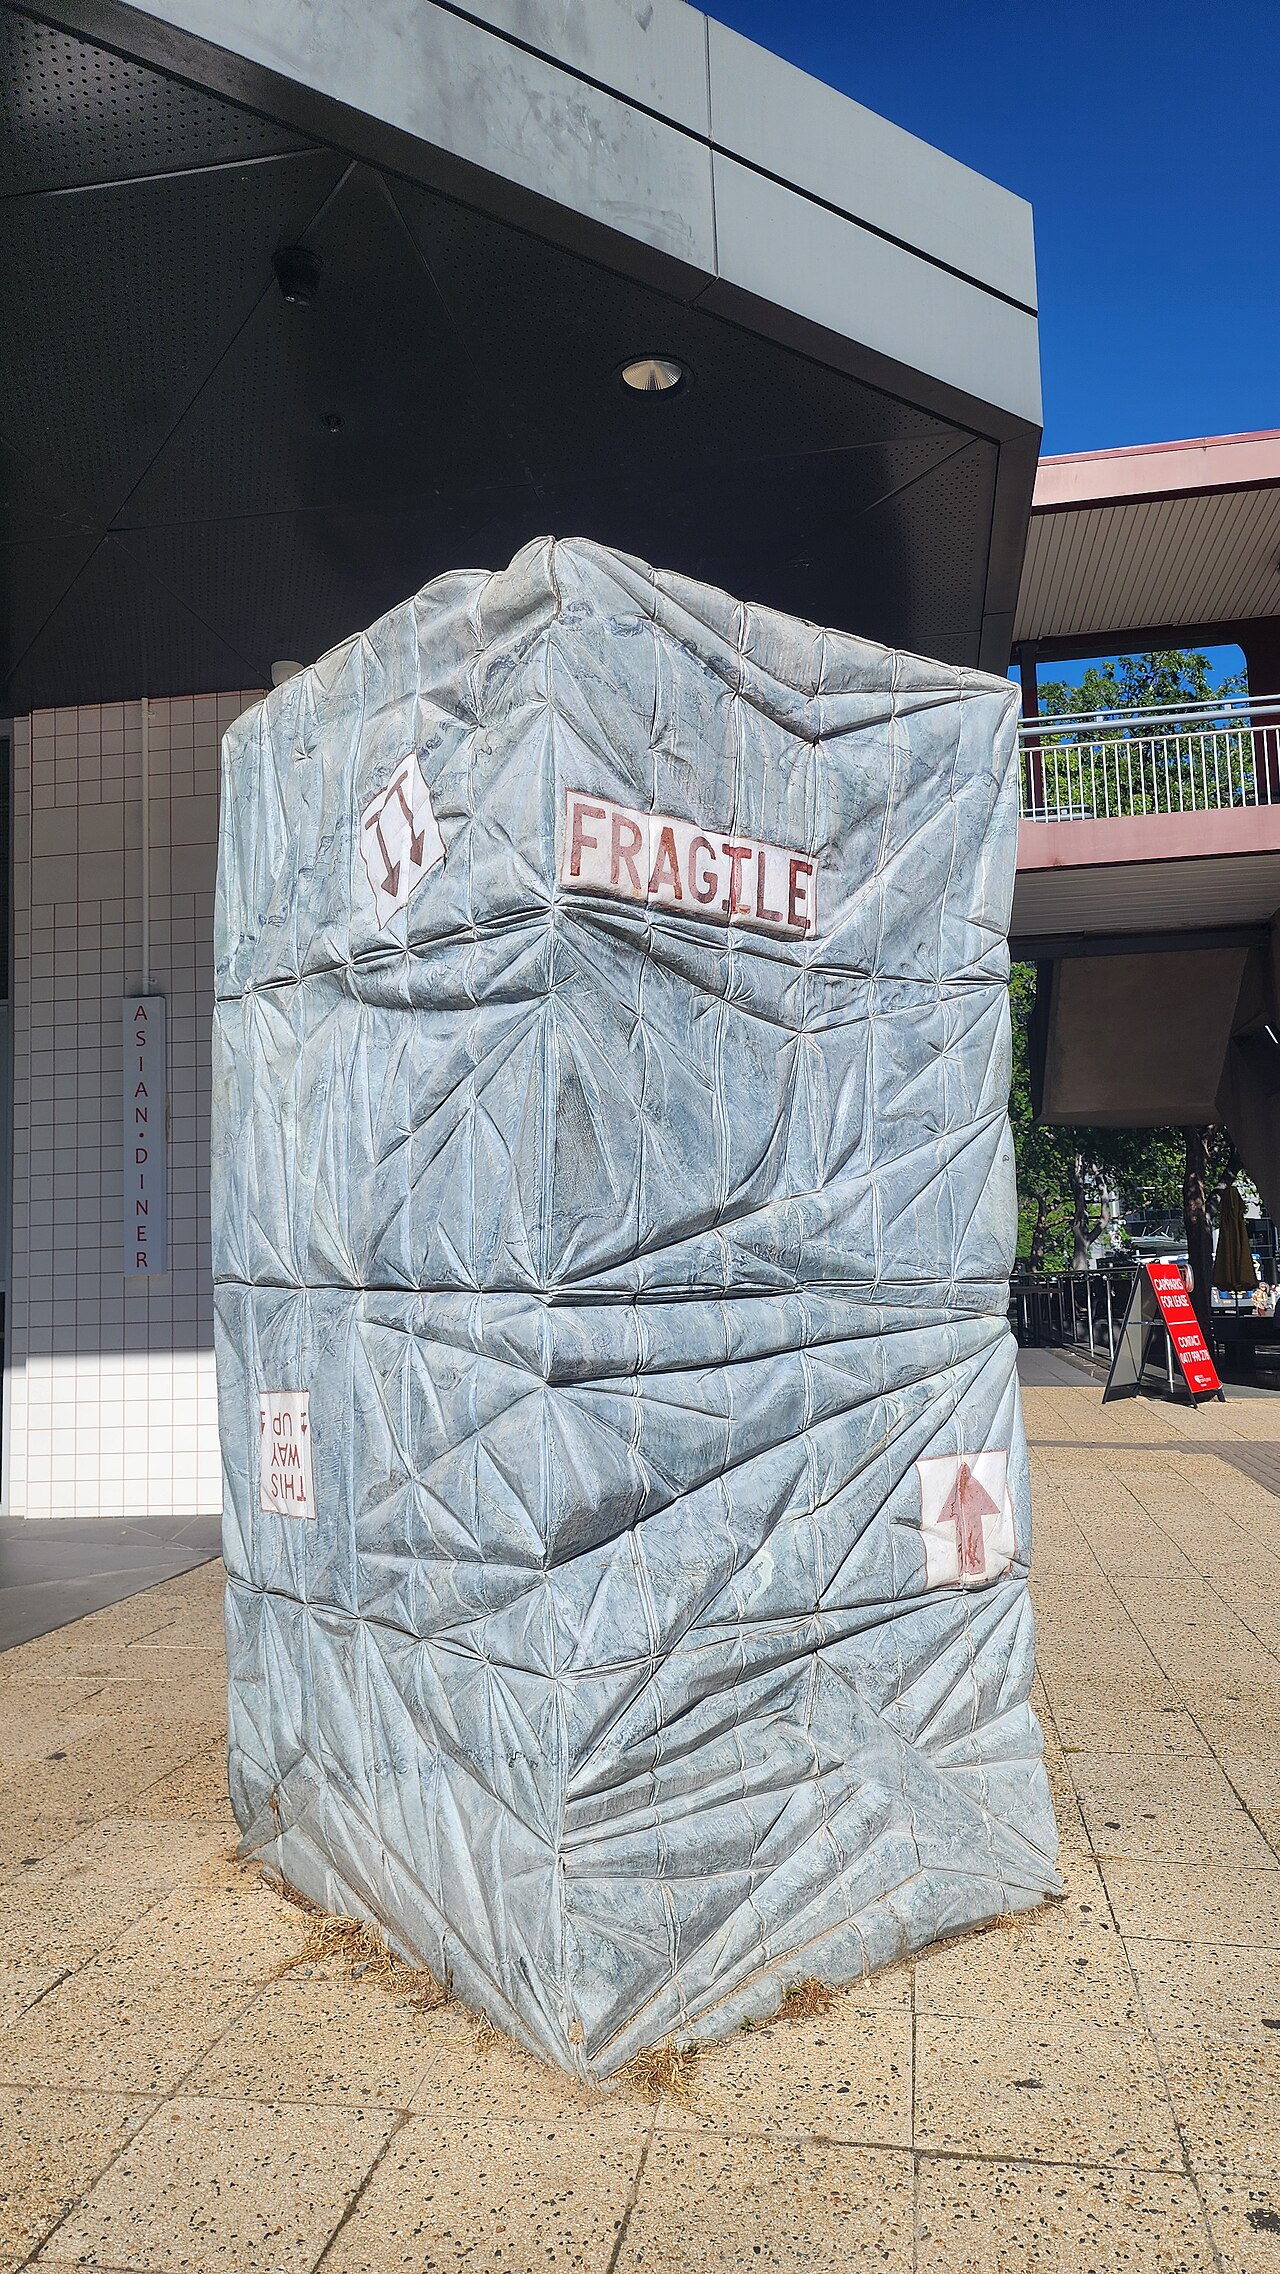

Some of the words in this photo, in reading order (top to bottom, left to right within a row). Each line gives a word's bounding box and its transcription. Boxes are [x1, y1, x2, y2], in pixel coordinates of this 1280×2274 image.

[570, 802, 813, 929] FRAGILE
[1160, 1295, 1174, 1308] FOR
[1172, 1294, 1190, 1308] LEASE
[1177, 1334, 1201, 1348] CONTACT
[272, 1411, 293, 1437] UP
[271, 1442, 300, 1469] WAY
[271, 1473, 307, 1502] THIS
